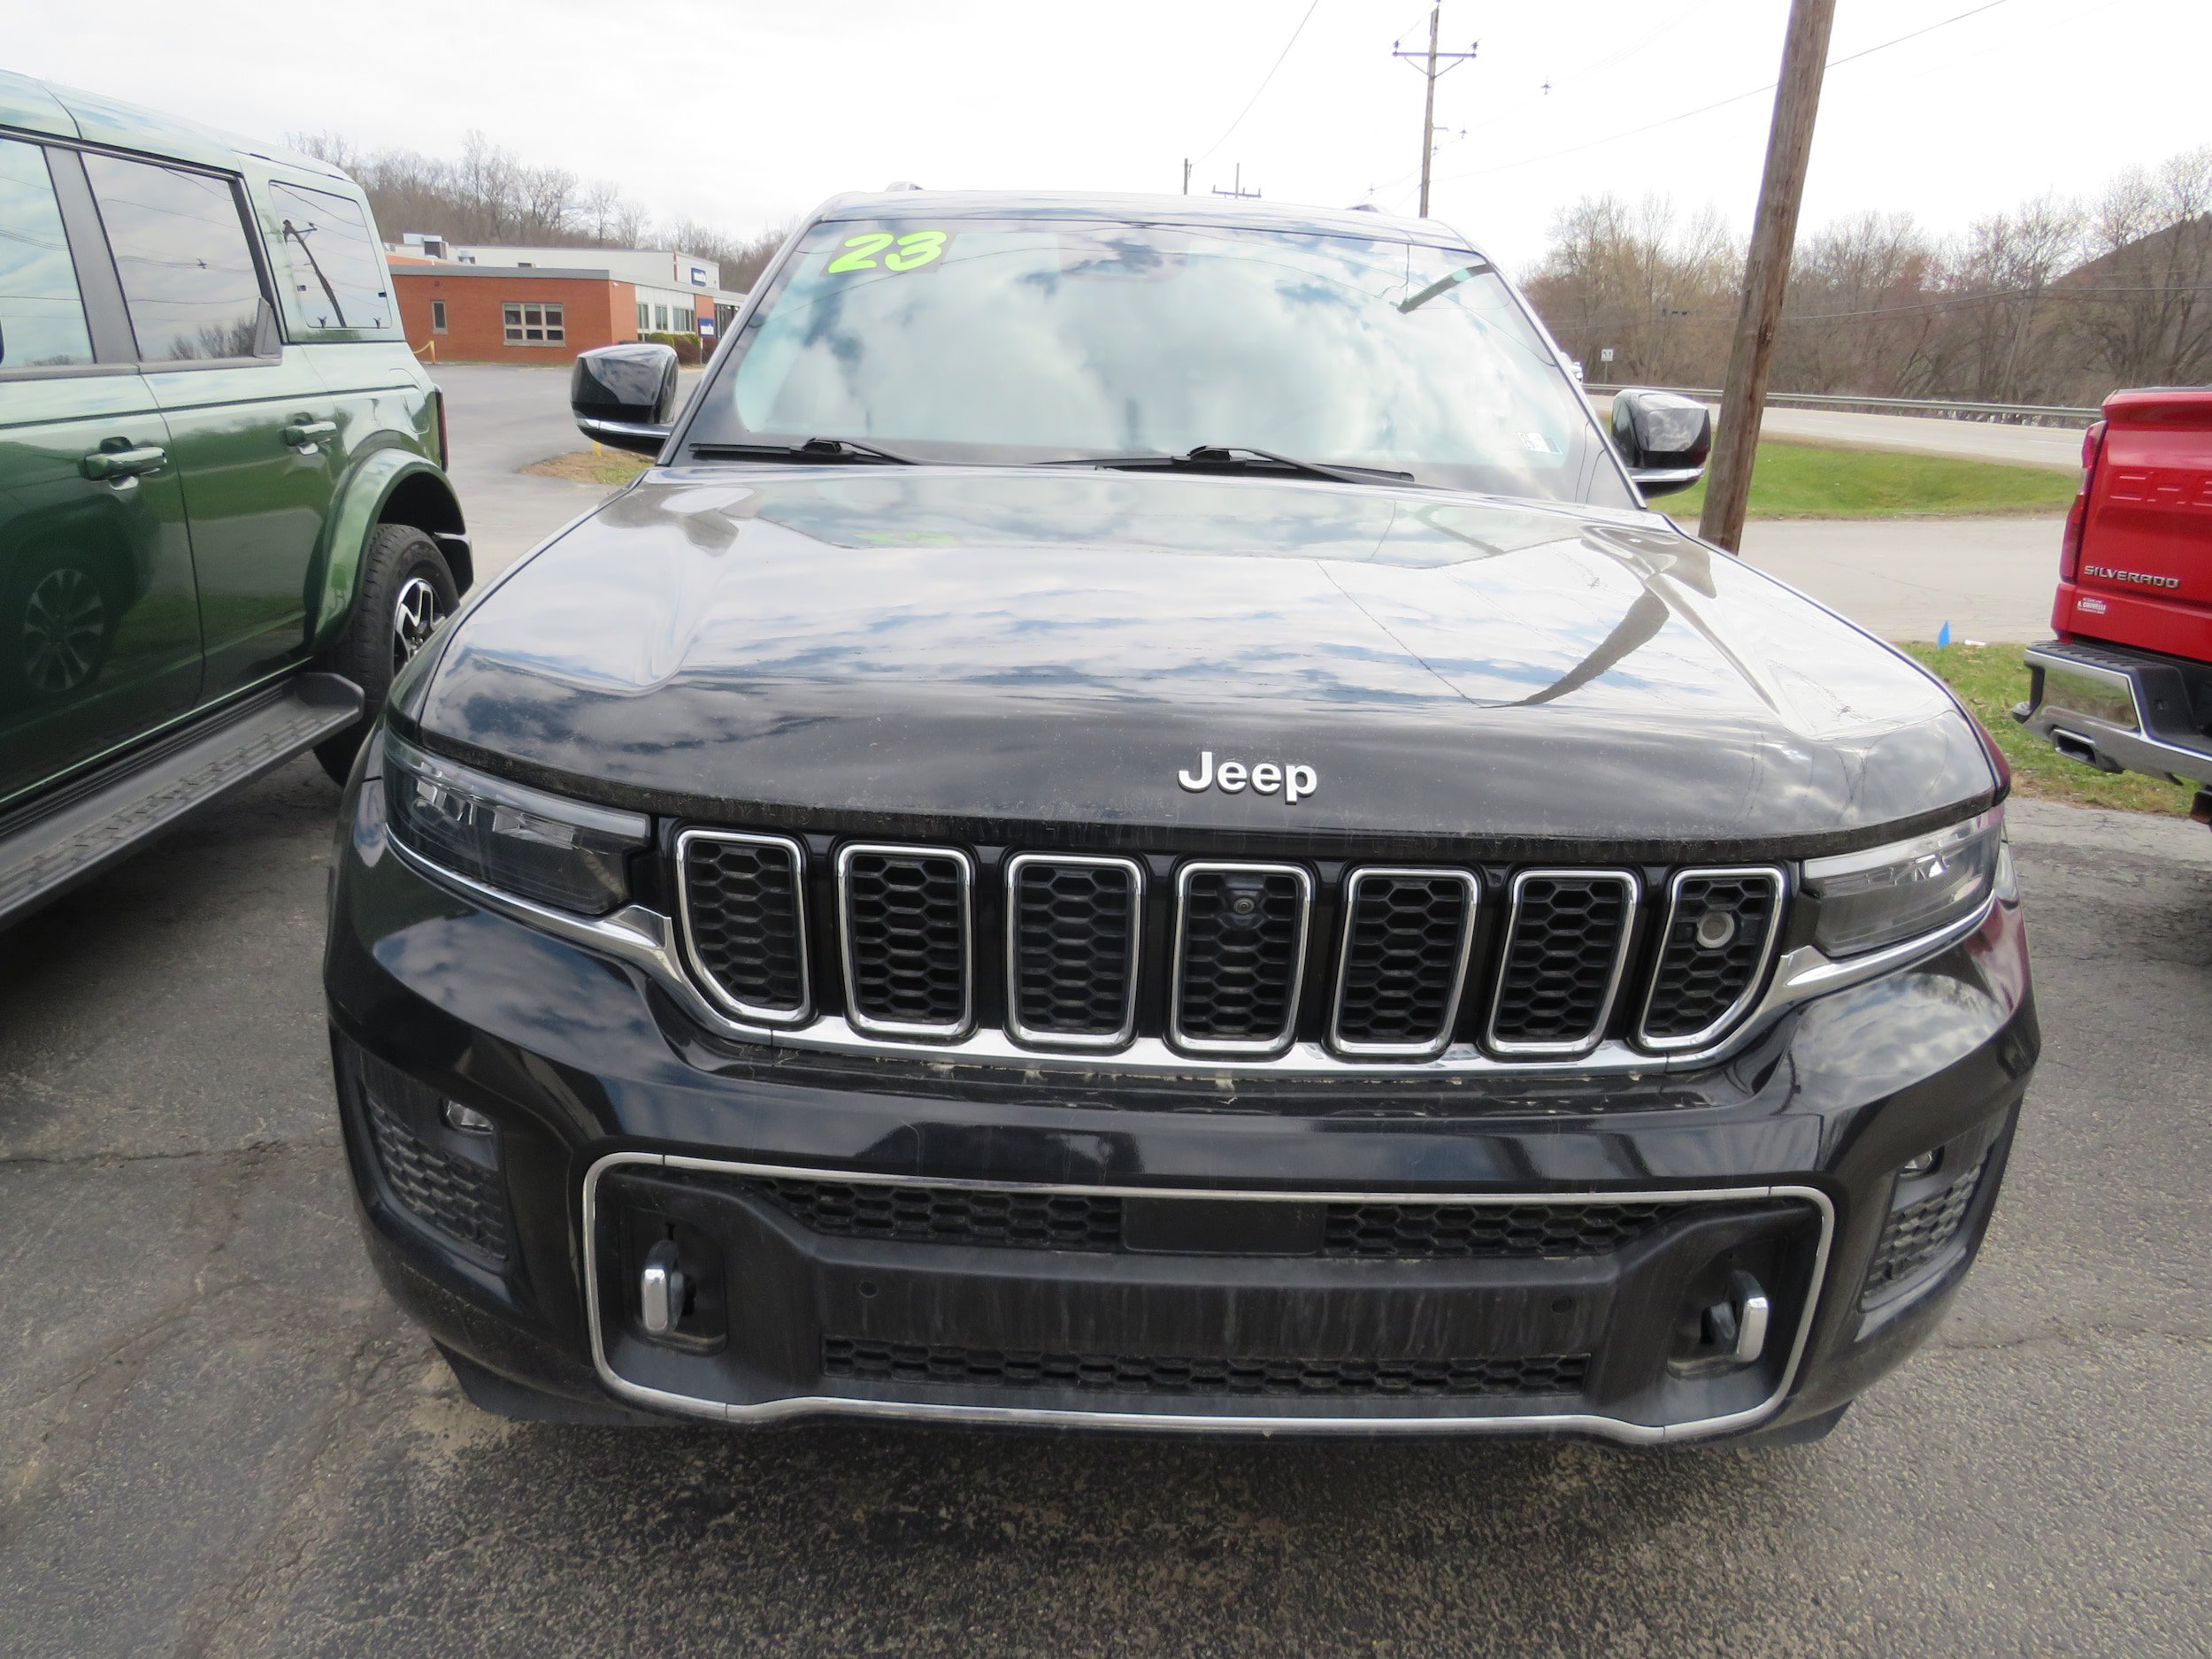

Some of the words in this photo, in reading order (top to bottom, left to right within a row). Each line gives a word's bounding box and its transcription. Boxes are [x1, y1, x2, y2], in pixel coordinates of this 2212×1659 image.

[827, 230, 948, 274] 23
[2084, 565, 2180, 589] SILVERADO
[1178, 751, 1317, 805] Jeep
